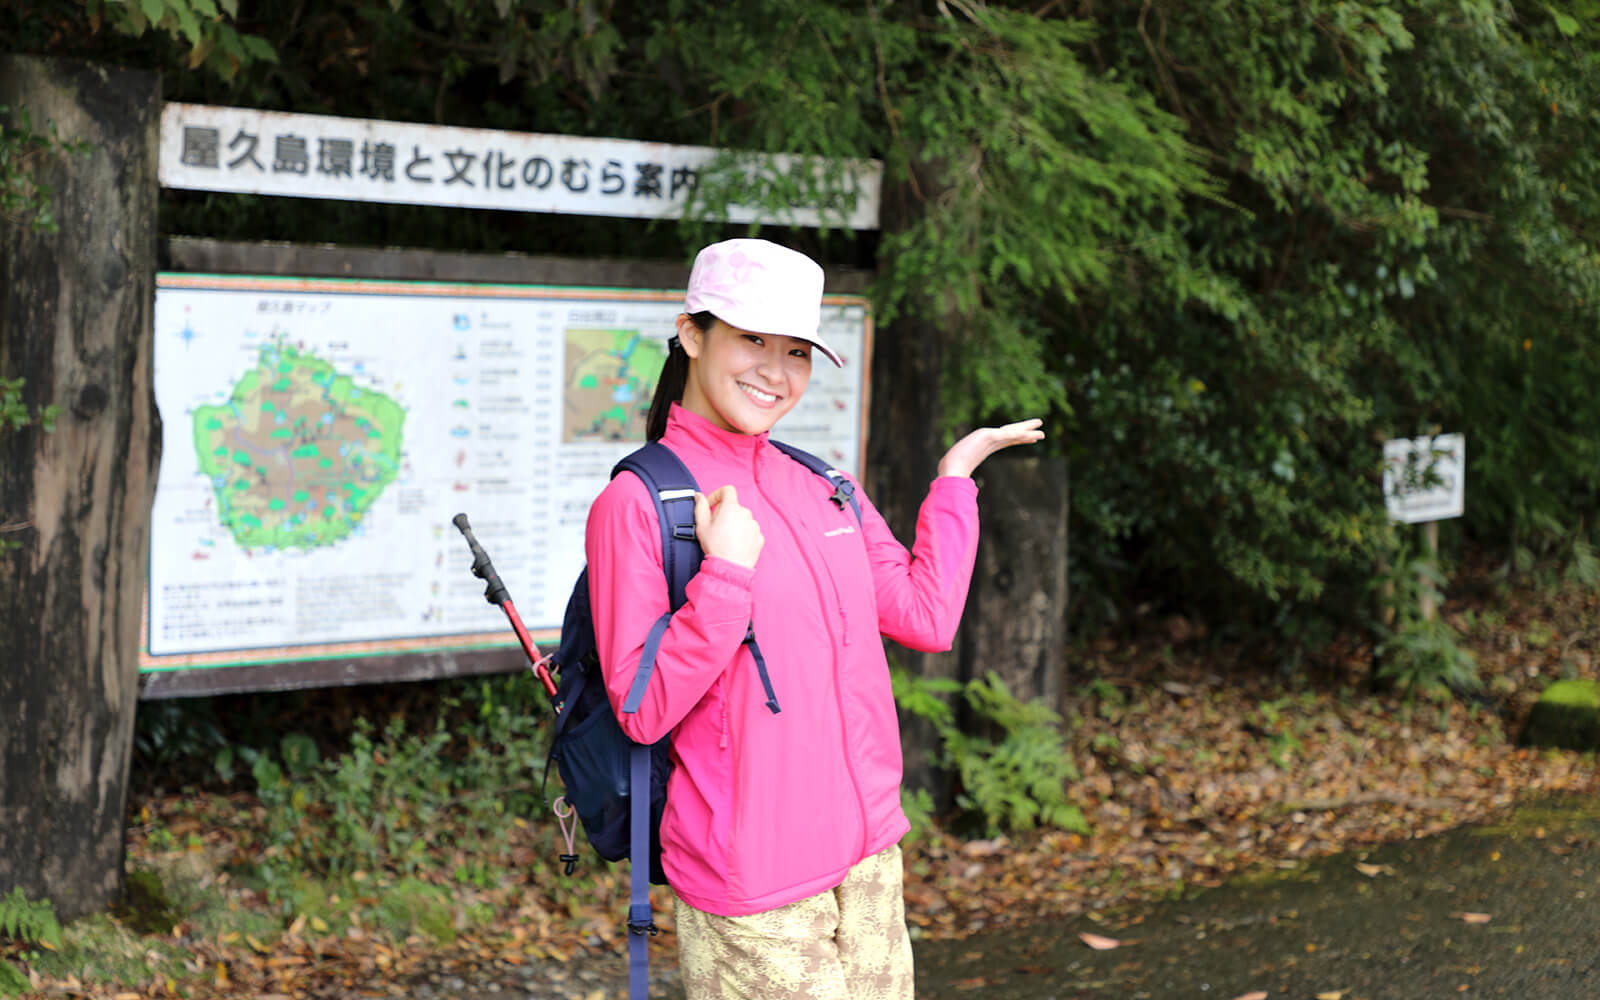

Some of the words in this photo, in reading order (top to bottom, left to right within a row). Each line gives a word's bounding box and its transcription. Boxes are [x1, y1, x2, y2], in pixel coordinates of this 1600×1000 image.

[180, 126, 858, 211] 屋久島環境と文化のむら案内
